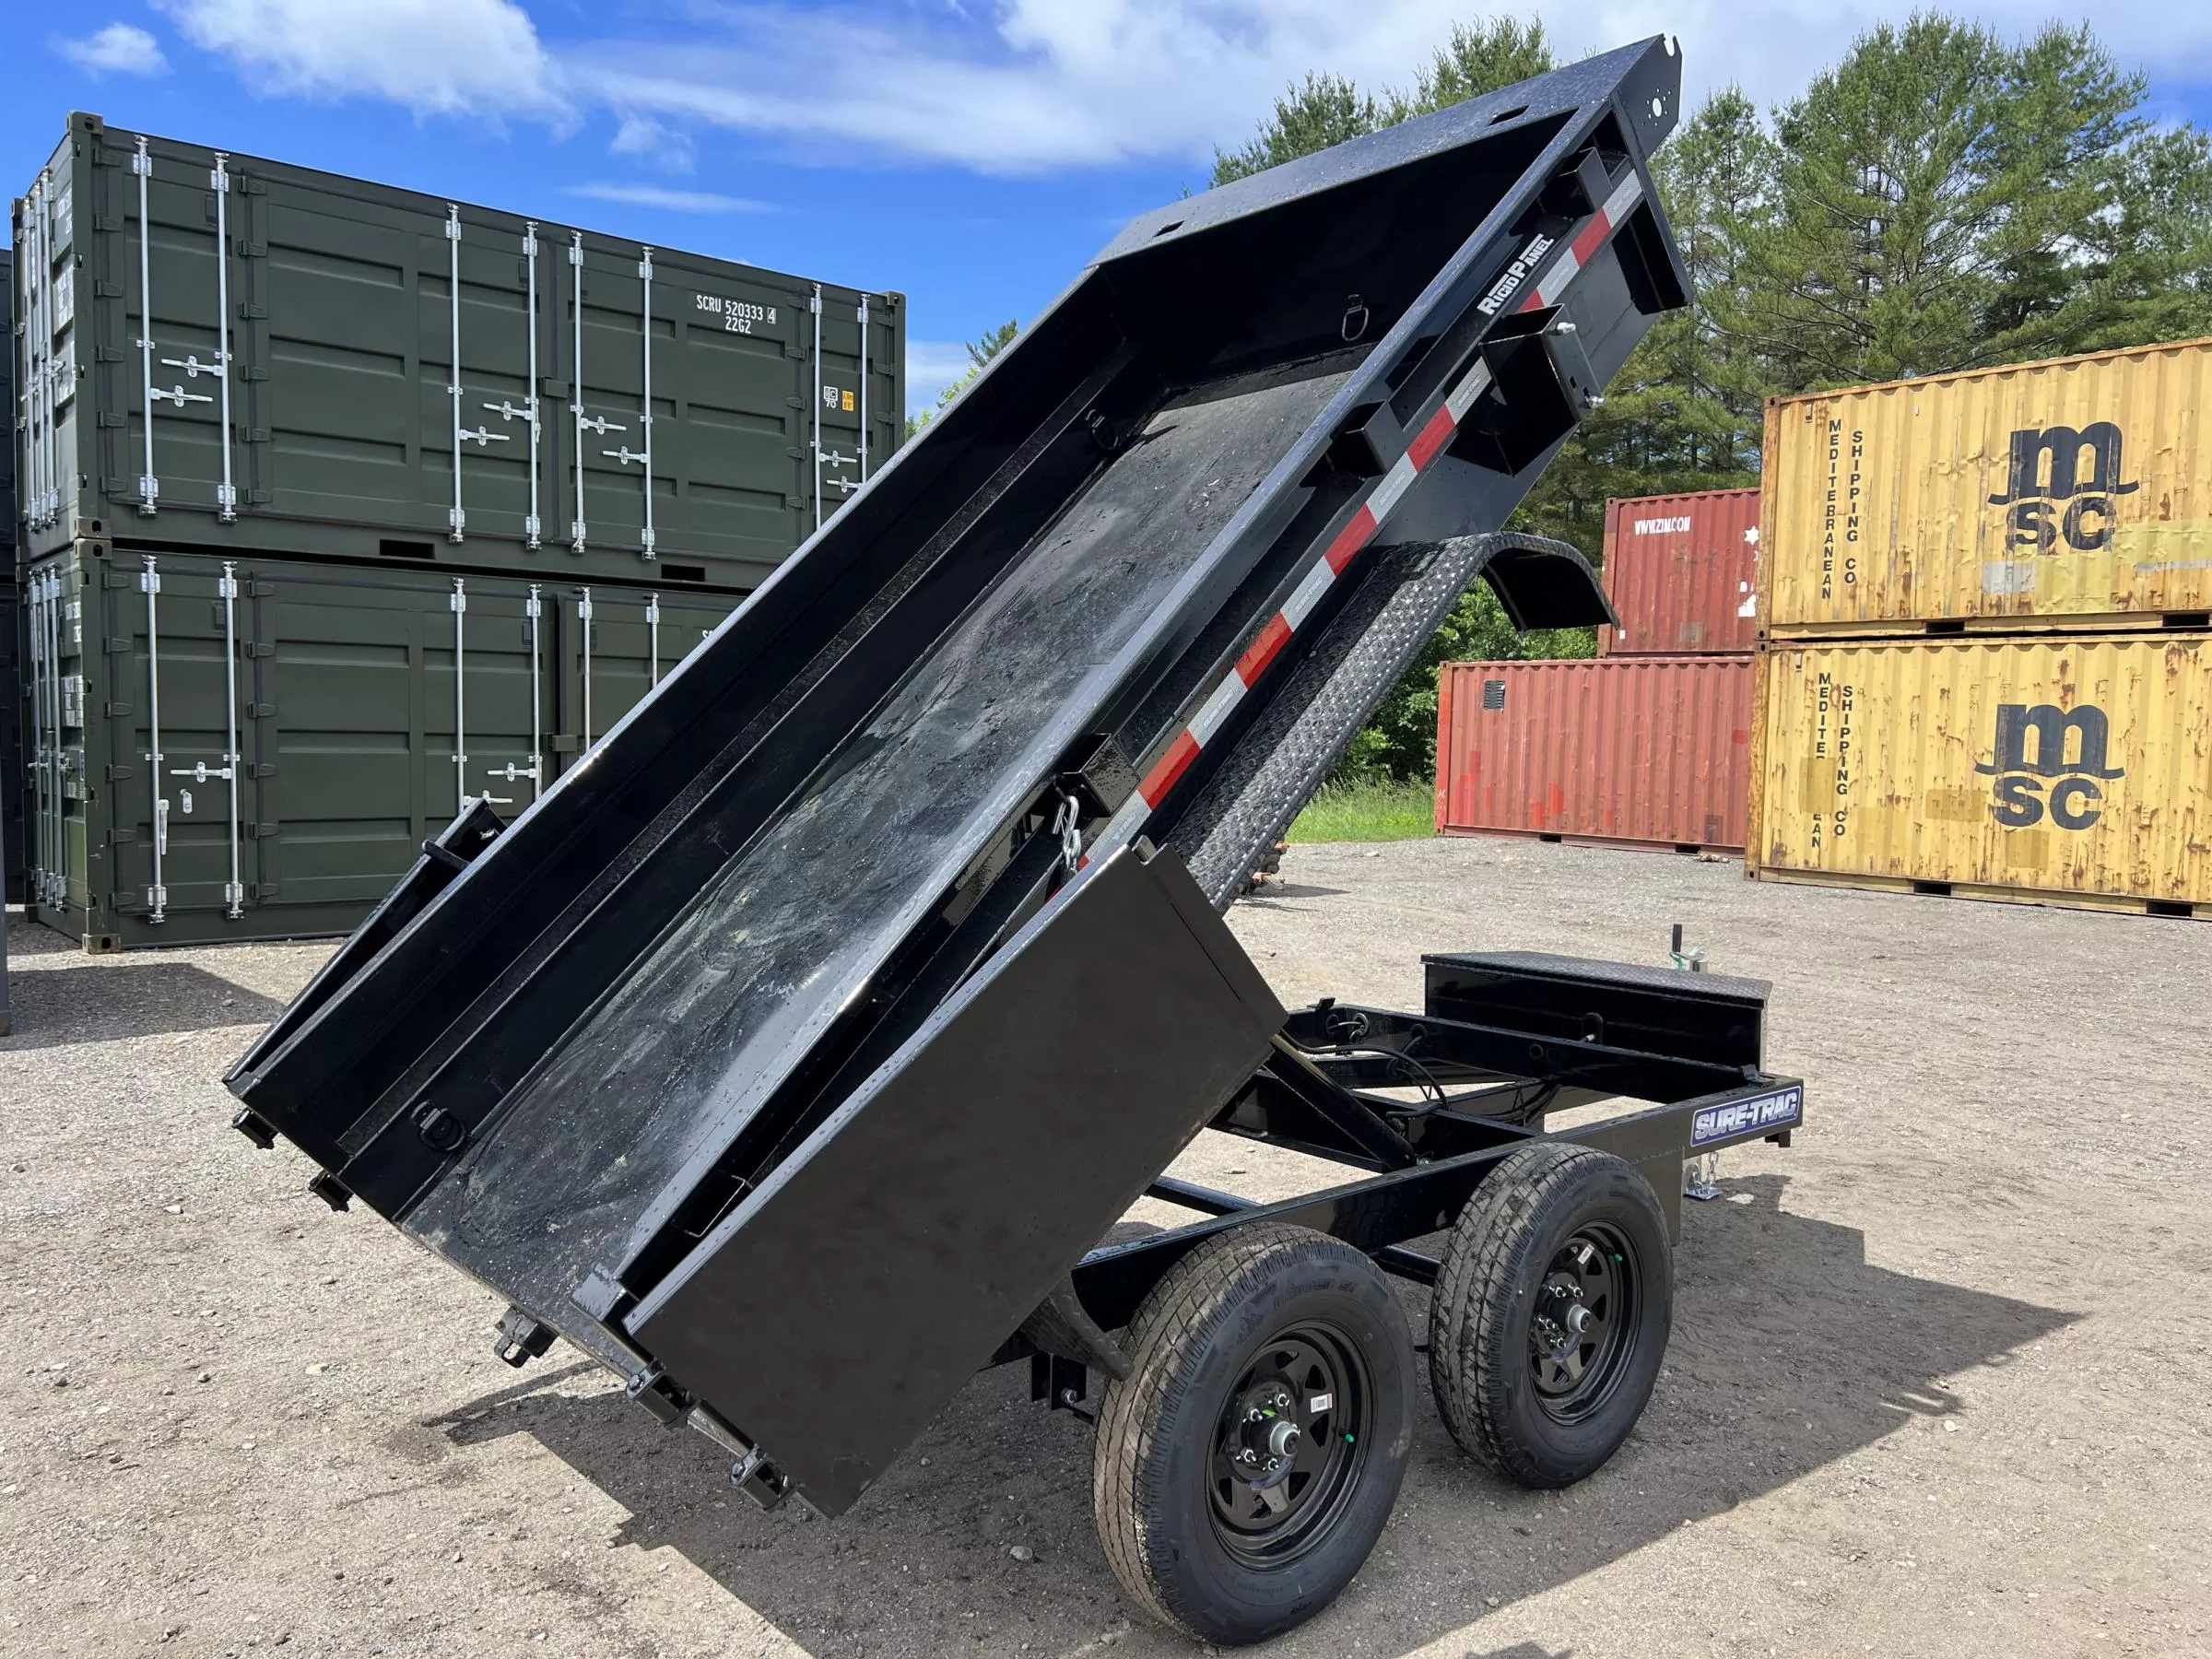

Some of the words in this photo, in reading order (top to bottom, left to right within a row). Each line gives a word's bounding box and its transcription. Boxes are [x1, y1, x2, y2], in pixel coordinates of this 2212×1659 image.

[696, 294, 722, 312] SCRU
[724, 300, 764, 321] 520333
[767, 307, 776, 324] 4
[724, 315, 751, 334] 22G2
[1822, 418, 1841, 599] MEDITERRANEAN
[1846, 430, 1863, 542] SHIPPING
[1836, 685, 1853, 794] SHIPPING
[1694, 1092, 1797, 1140] SURE-TRAC
